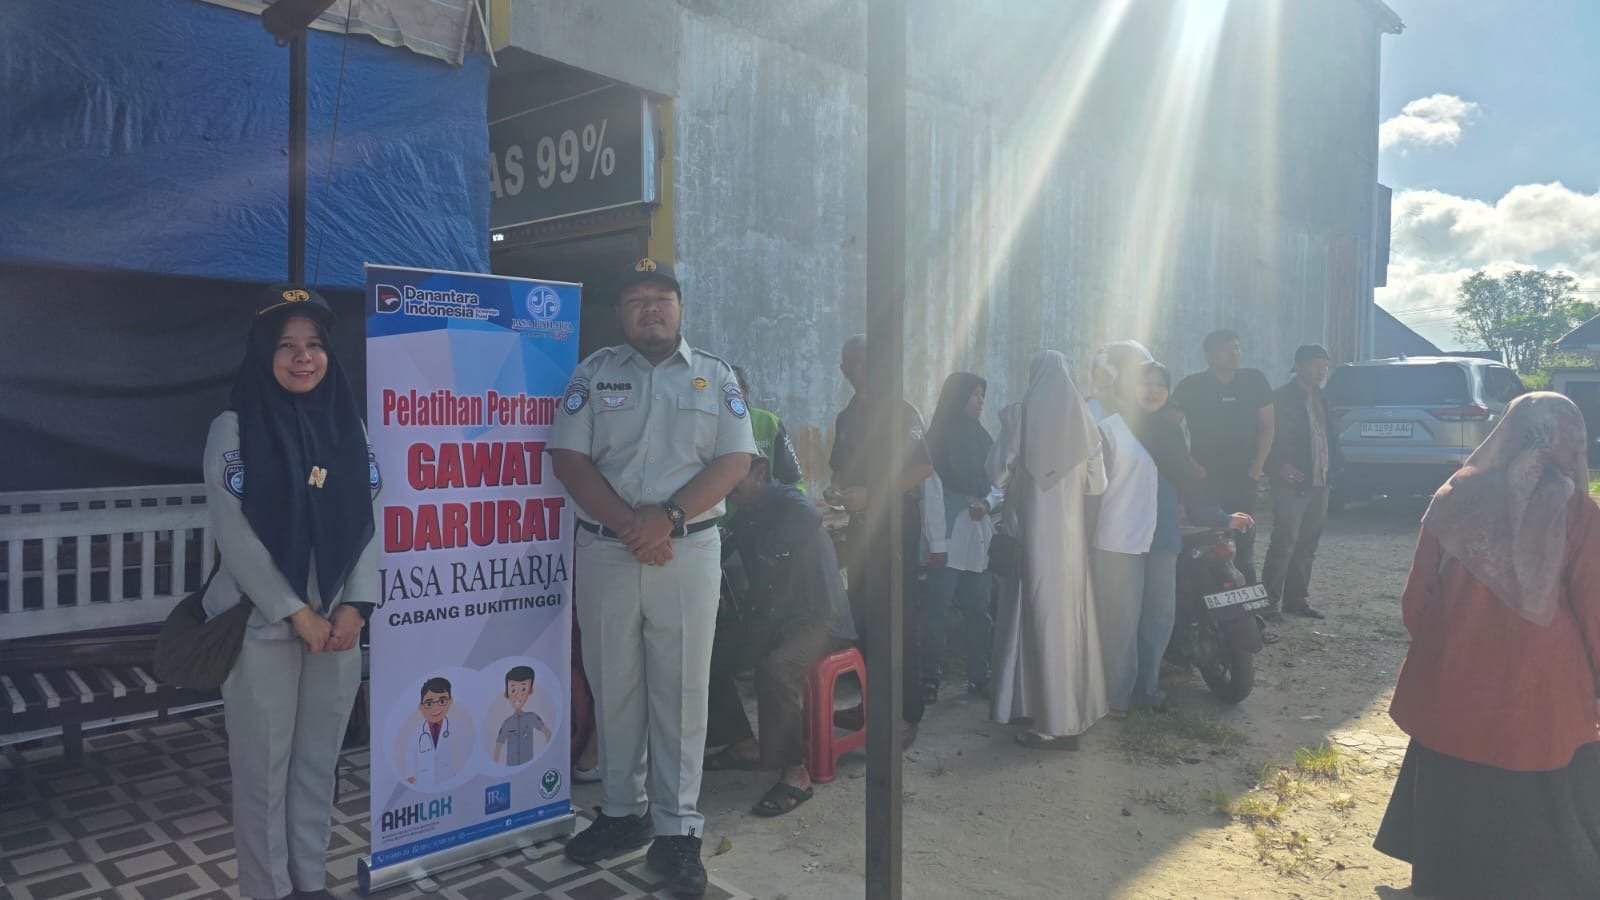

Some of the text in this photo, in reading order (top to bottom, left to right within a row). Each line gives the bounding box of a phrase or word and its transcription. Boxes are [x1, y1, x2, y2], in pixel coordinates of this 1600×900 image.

[537, 119, 615, 189] 99%
[405, 285, 478, 305] Danantara
[405, 303, 473, 318] Indonesia
[383, 389, 482, 426] Pelatihan
[407, 441, 547, 491] GAWAT
[384, 497, 566, 553] DARURAT
[377, 552, 568, 609] JASA RAHARJA
[1206, 595, 1221, 608] BA
[1224, 589, 1249, 603] 2715
[389, 594, 561, 627] CABANG BUKITTINGGI
[381, 795, 452, 832] AKHLAK
